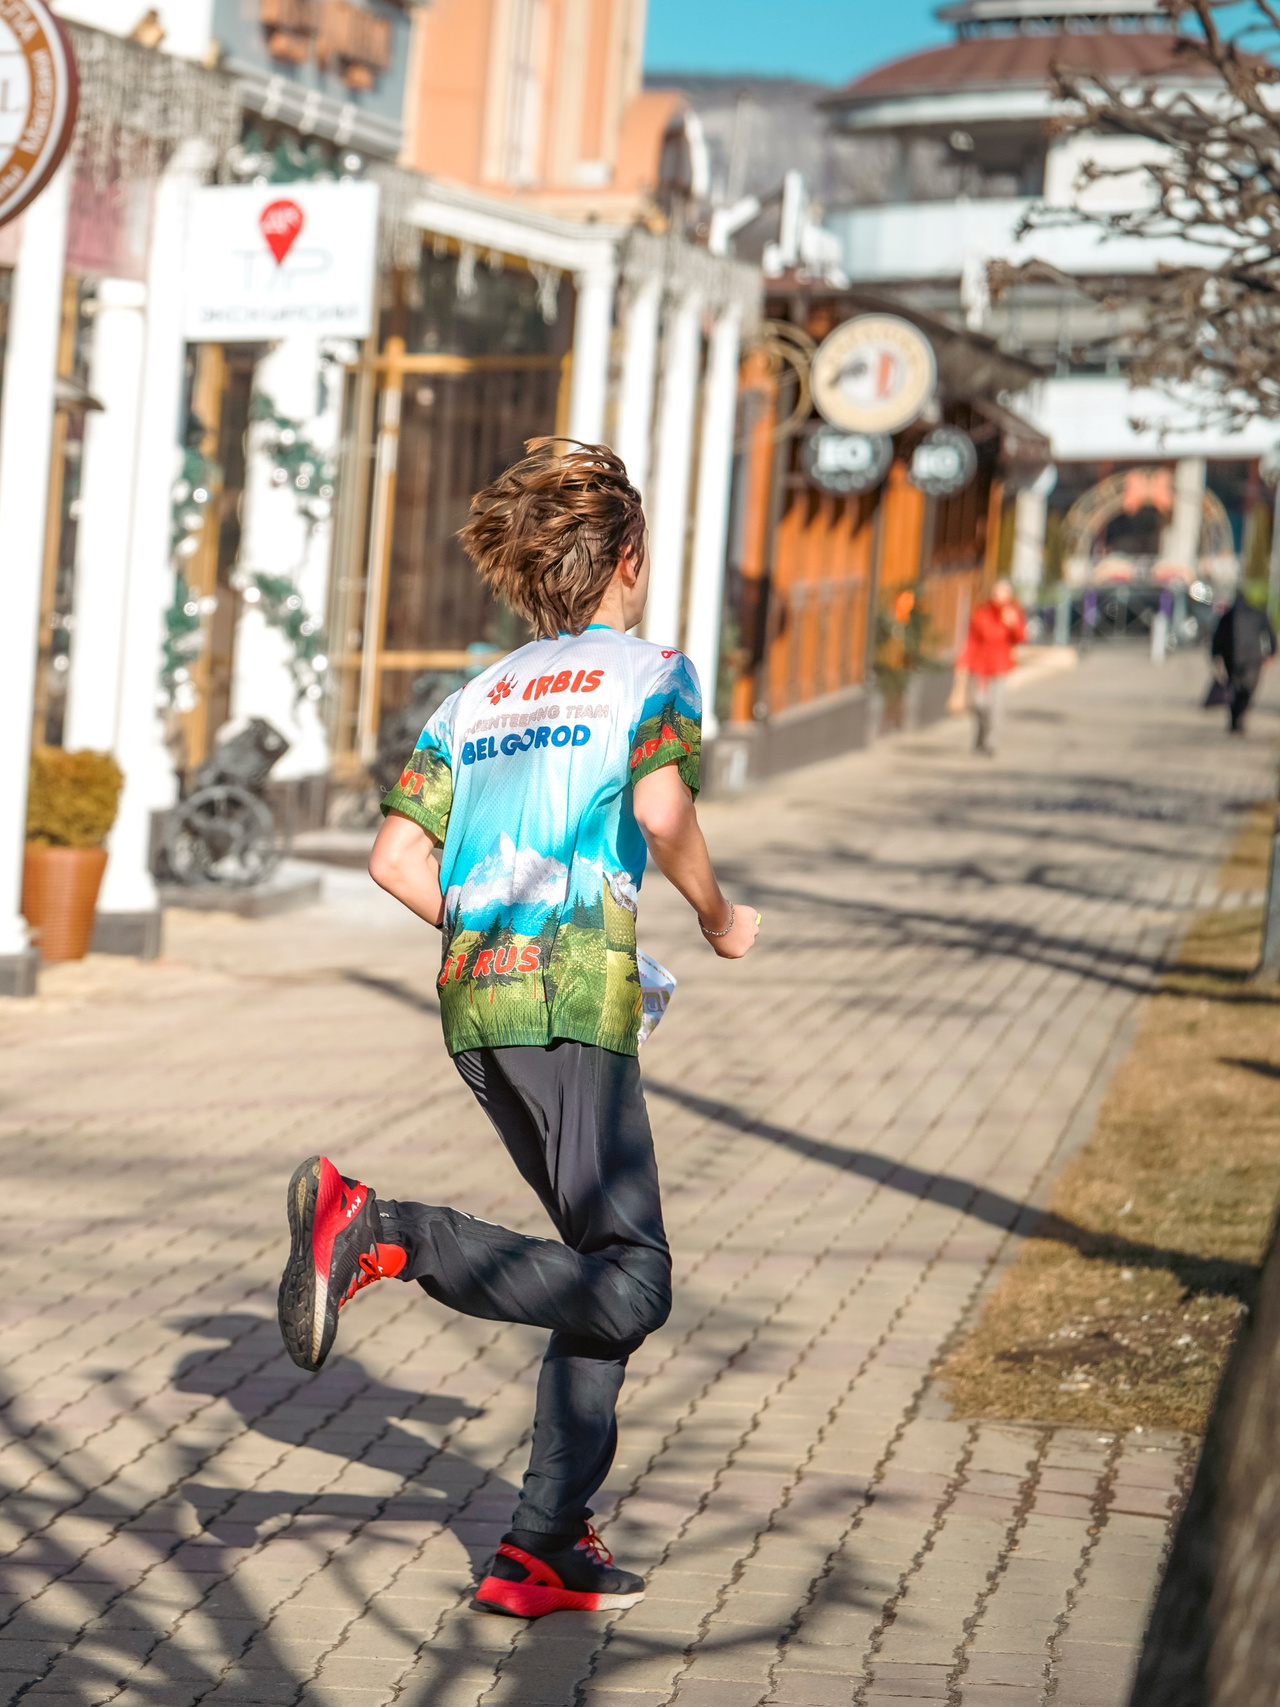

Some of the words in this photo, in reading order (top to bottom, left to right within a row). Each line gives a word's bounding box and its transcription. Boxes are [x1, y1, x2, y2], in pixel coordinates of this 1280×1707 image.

[522, 669, 605, 700] IRBIS
[566, 704, 610, 719] TEAM
[461, 724, 591, 765] BELGOROD
[472, 945, 542, 978] RUS
